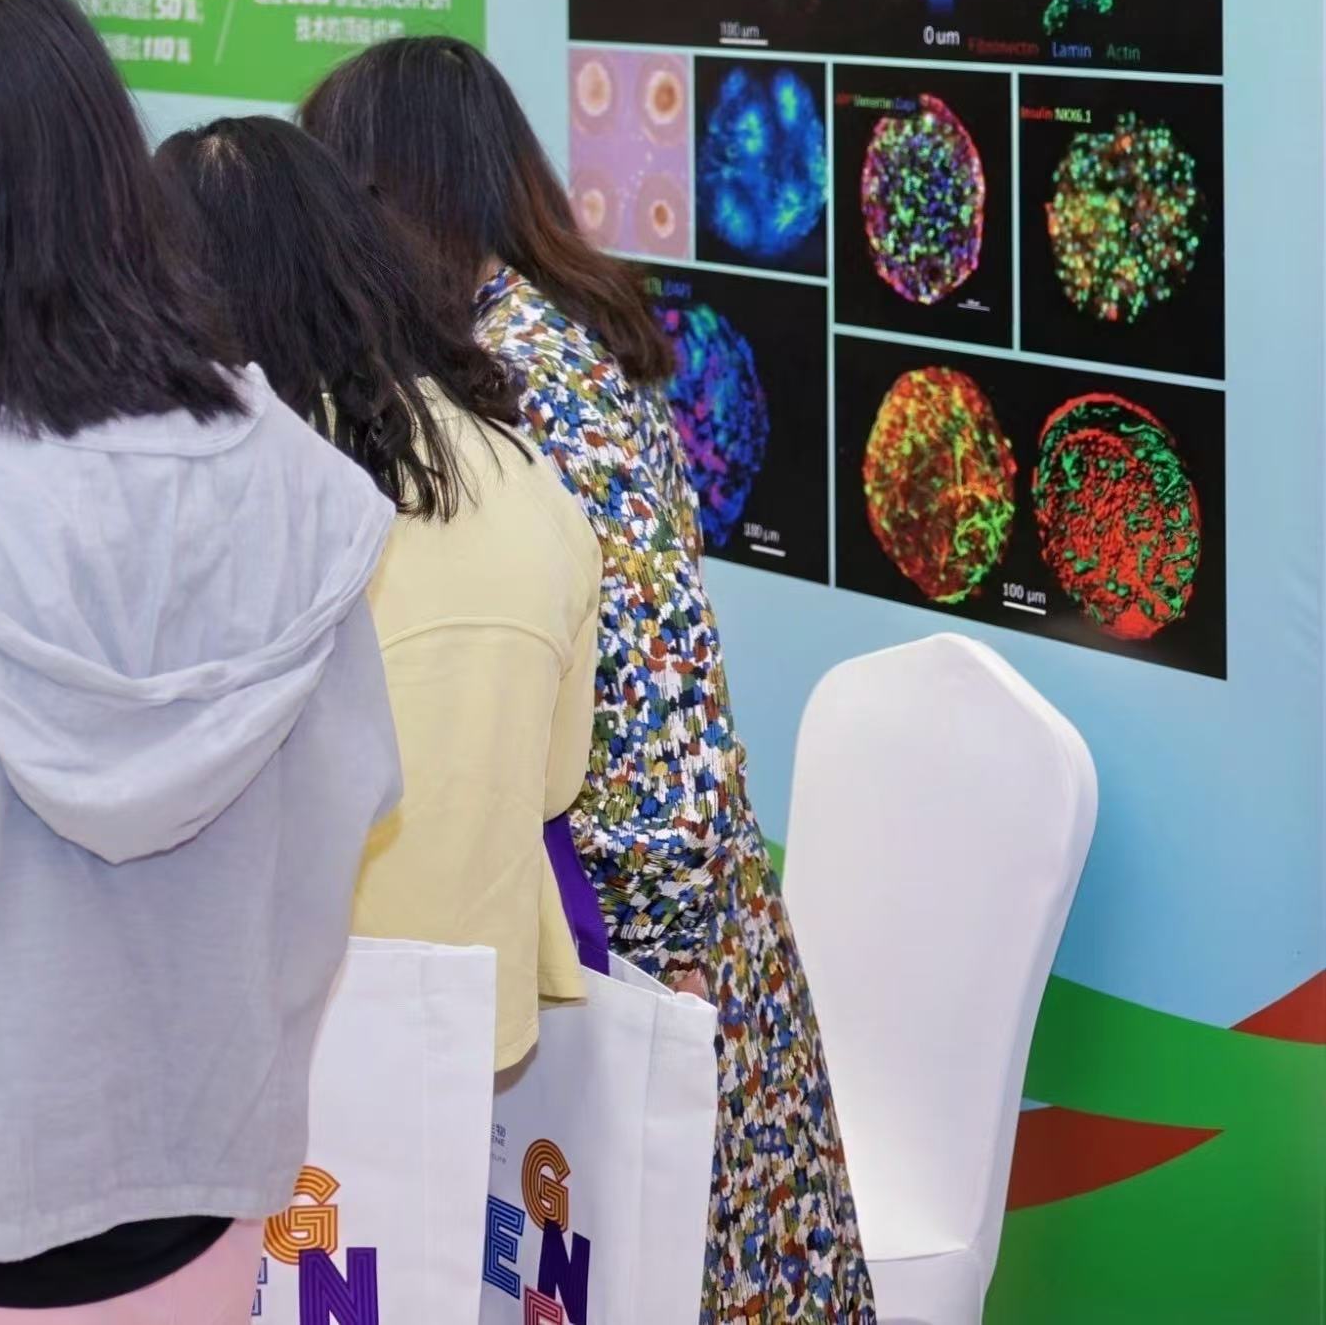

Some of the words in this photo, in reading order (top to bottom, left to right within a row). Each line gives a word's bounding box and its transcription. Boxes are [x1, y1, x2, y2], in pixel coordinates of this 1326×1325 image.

[1052, 40, 1092, 58] Lamin
[1105, 42, 1142, 61] Actin
[1002, 582, 1024, 601] 100
